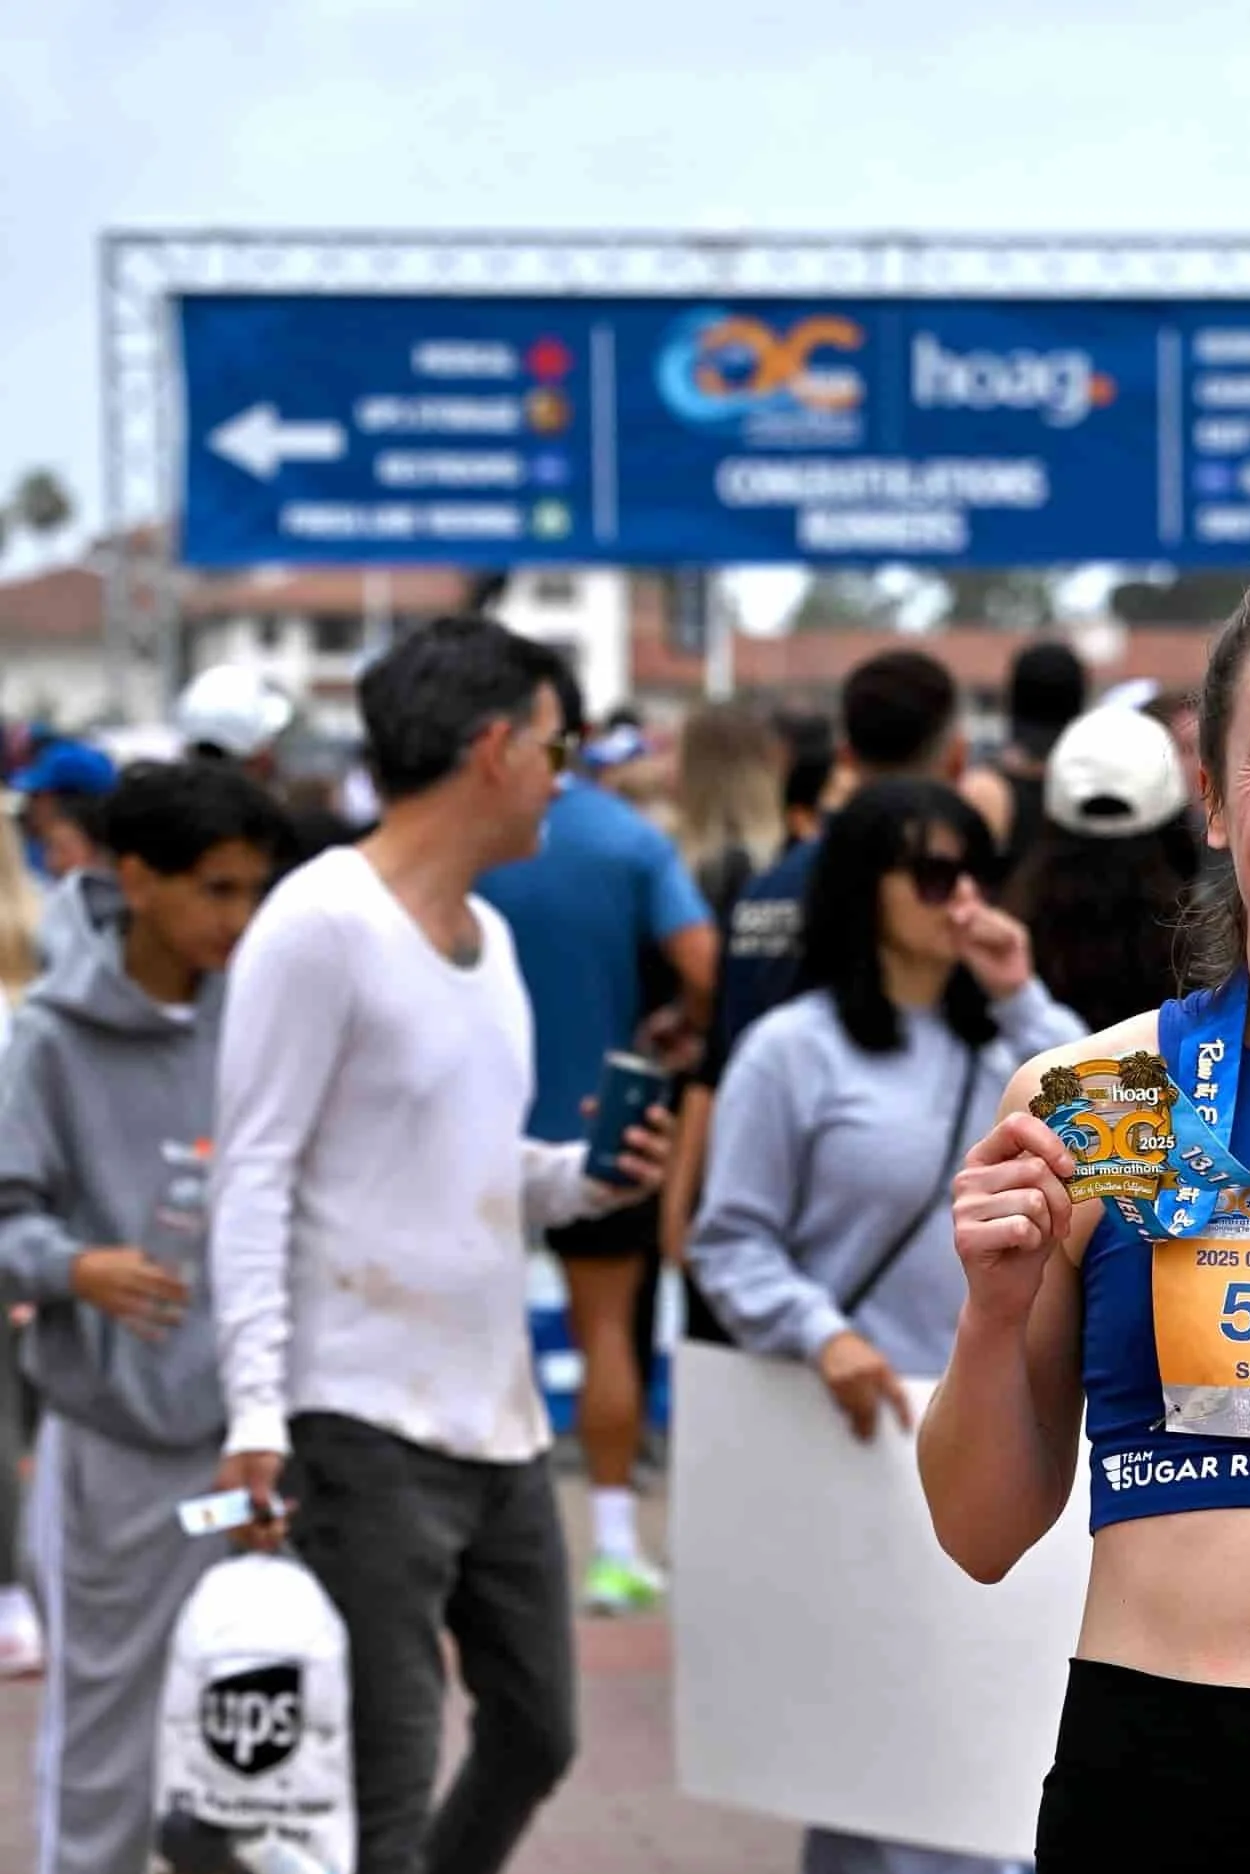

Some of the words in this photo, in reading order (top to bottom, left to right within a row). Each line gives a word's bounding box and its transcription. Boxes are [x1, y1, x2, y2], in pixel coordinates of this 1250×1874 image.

[1139, 1135, 1176, 1150] 2025
[1099, 1162, 1159, 1175] marathon
[1196, 1250, 1239, 1267] 2025
[1121, 1450, 1154, 1465] TEAM
[1121, 1456, 1219, 1490] SUGAR
[203, 1690, 302, 1767] ups
